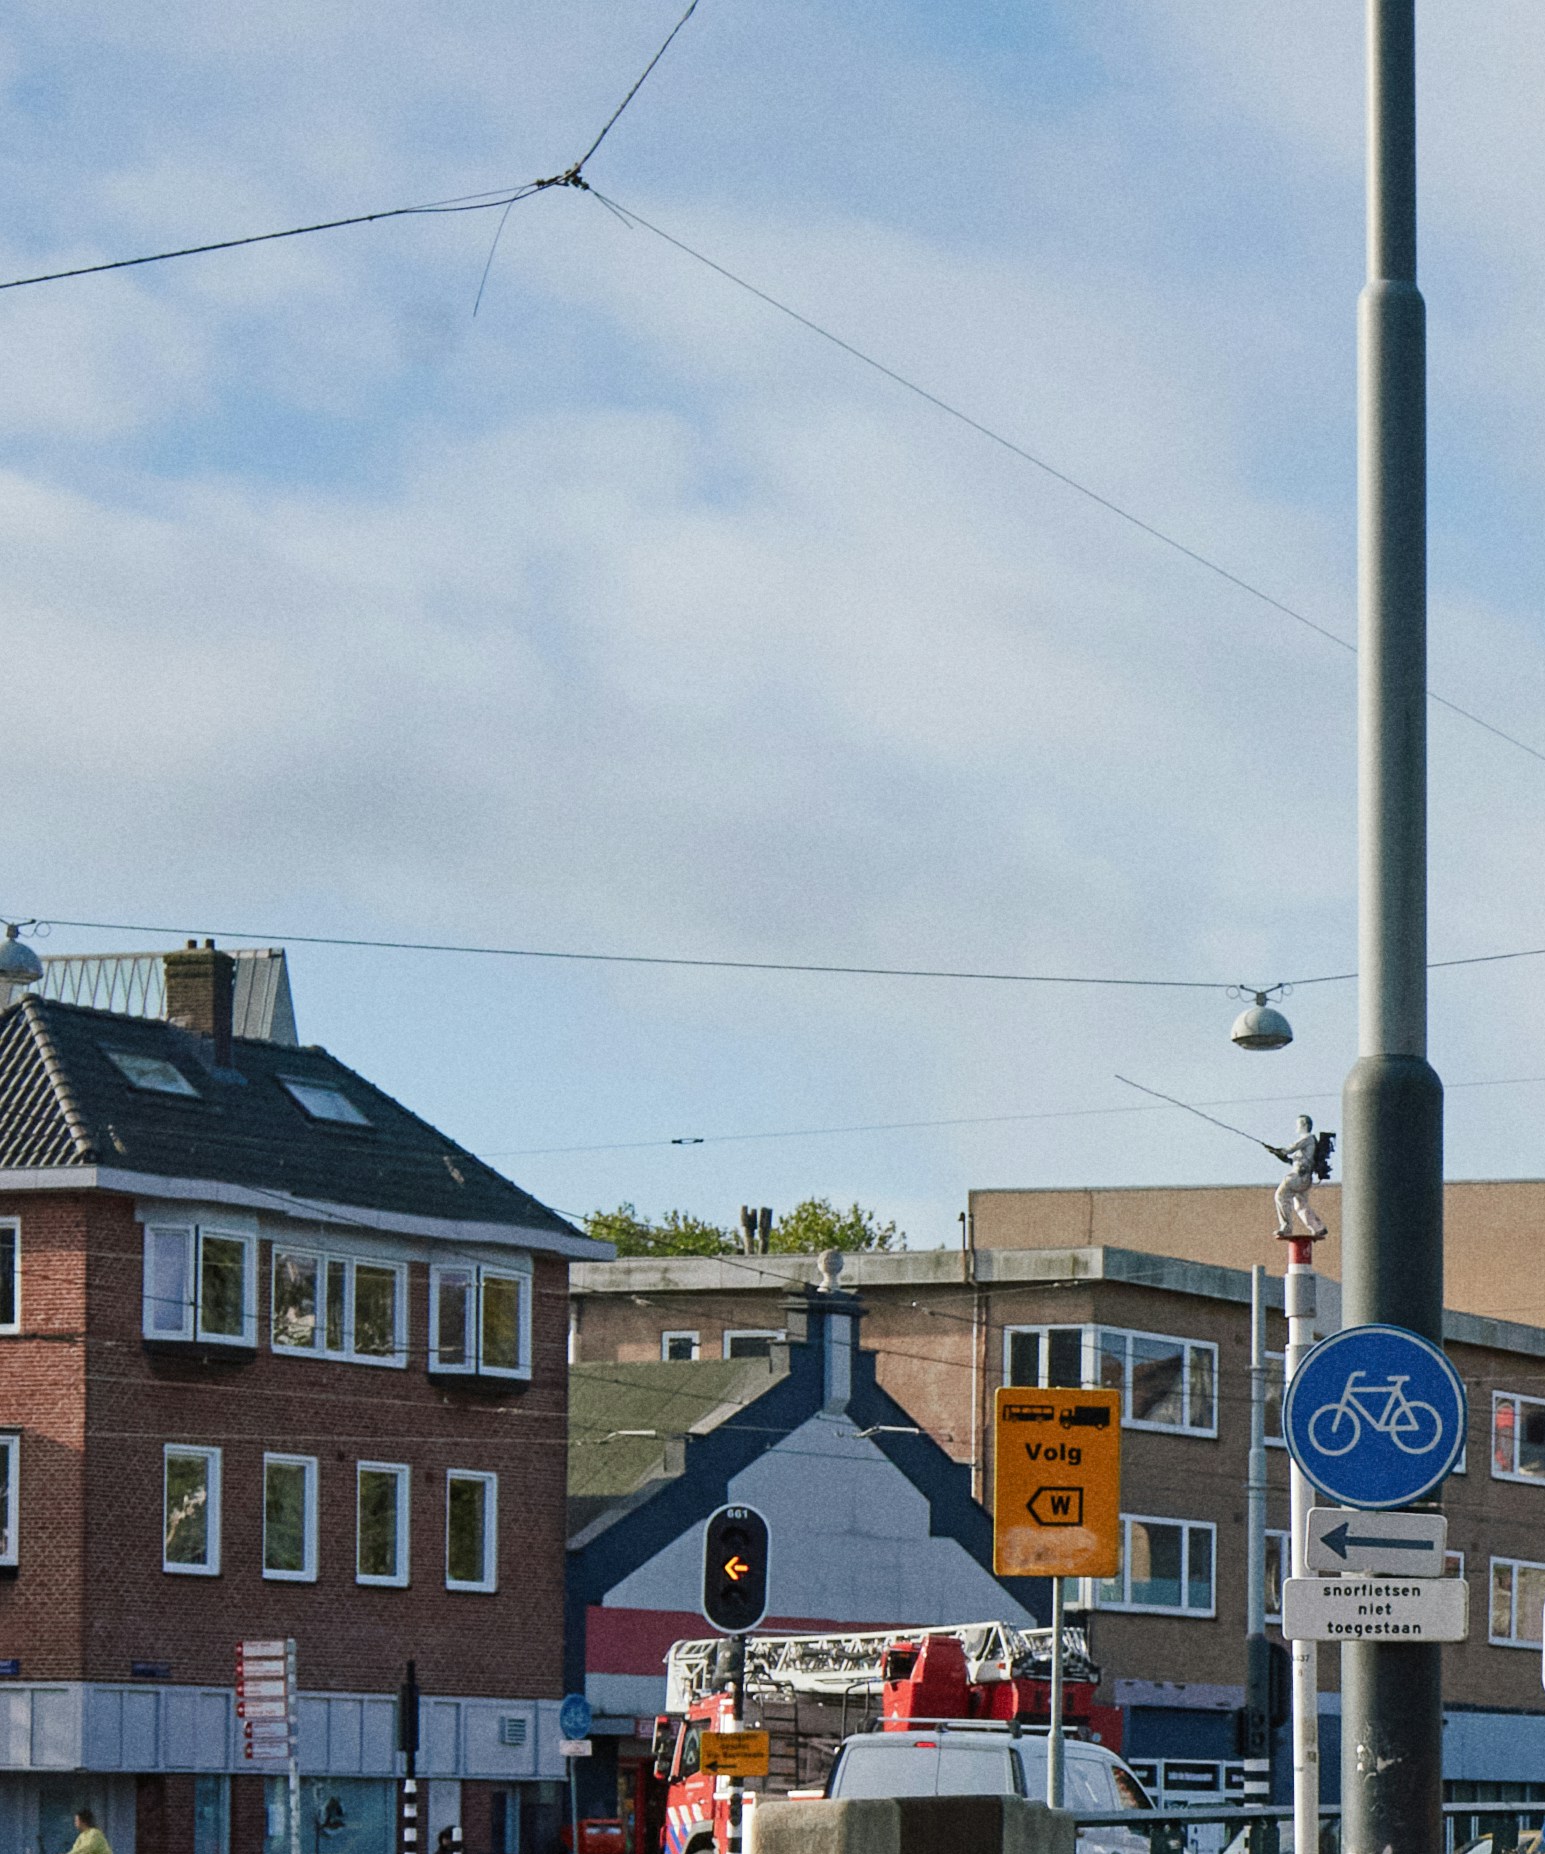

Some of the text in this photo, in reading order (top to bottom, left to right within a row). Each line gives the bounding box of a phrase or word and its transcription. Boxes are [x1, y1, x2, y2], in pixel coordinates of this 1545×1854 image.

[1025, 1442, 1081, 1466] Volg
[1050, 1495, 1071, 1516] W
[1323, 1584, 1421, 1597] snorfietsen
[1358, 1602, 1392, 1615] niet
[1327, 1621, 1421, 1637] toegestaan
